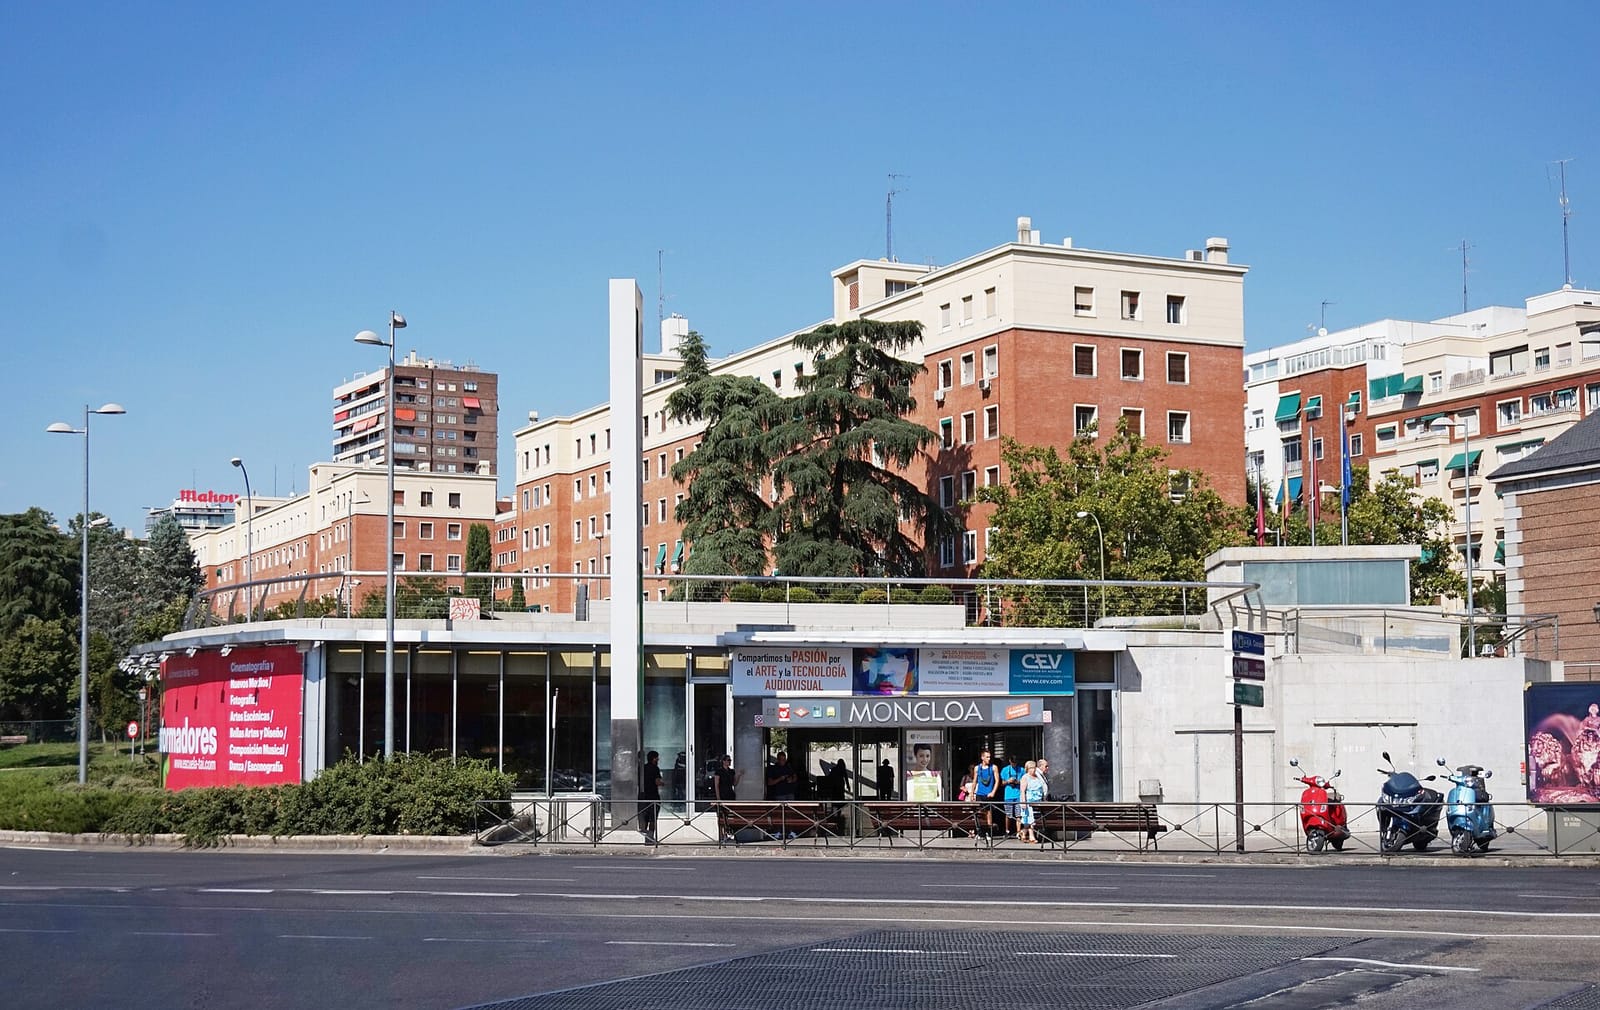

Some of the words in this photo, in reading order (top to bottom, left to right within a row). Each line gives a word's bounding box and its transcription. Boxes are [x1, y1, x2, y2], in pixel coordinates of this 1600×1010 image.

[737, 653, 783, 664] Compartimos
[784, 654, 791, 663] tu
[791, 649, 828, 663] PASIÓN
[829, 656, 841, 665] por
[1021, 653, 1063, 670] CEV
[746, 667, 753, 676] el
[755, 665, 777, 677] ARTE
[779, 670, 783, 678] y
[784, 667, 791, 677] la
[792, 664, 847, 677] TECNOLOGÍA
[764, 679, 824, 691] AUDIOVISUAL
[230, 711, 244, 721] Artes
[849, 701, 984, 722] MONCLOA
[244, 727, 260, 738] Artes
